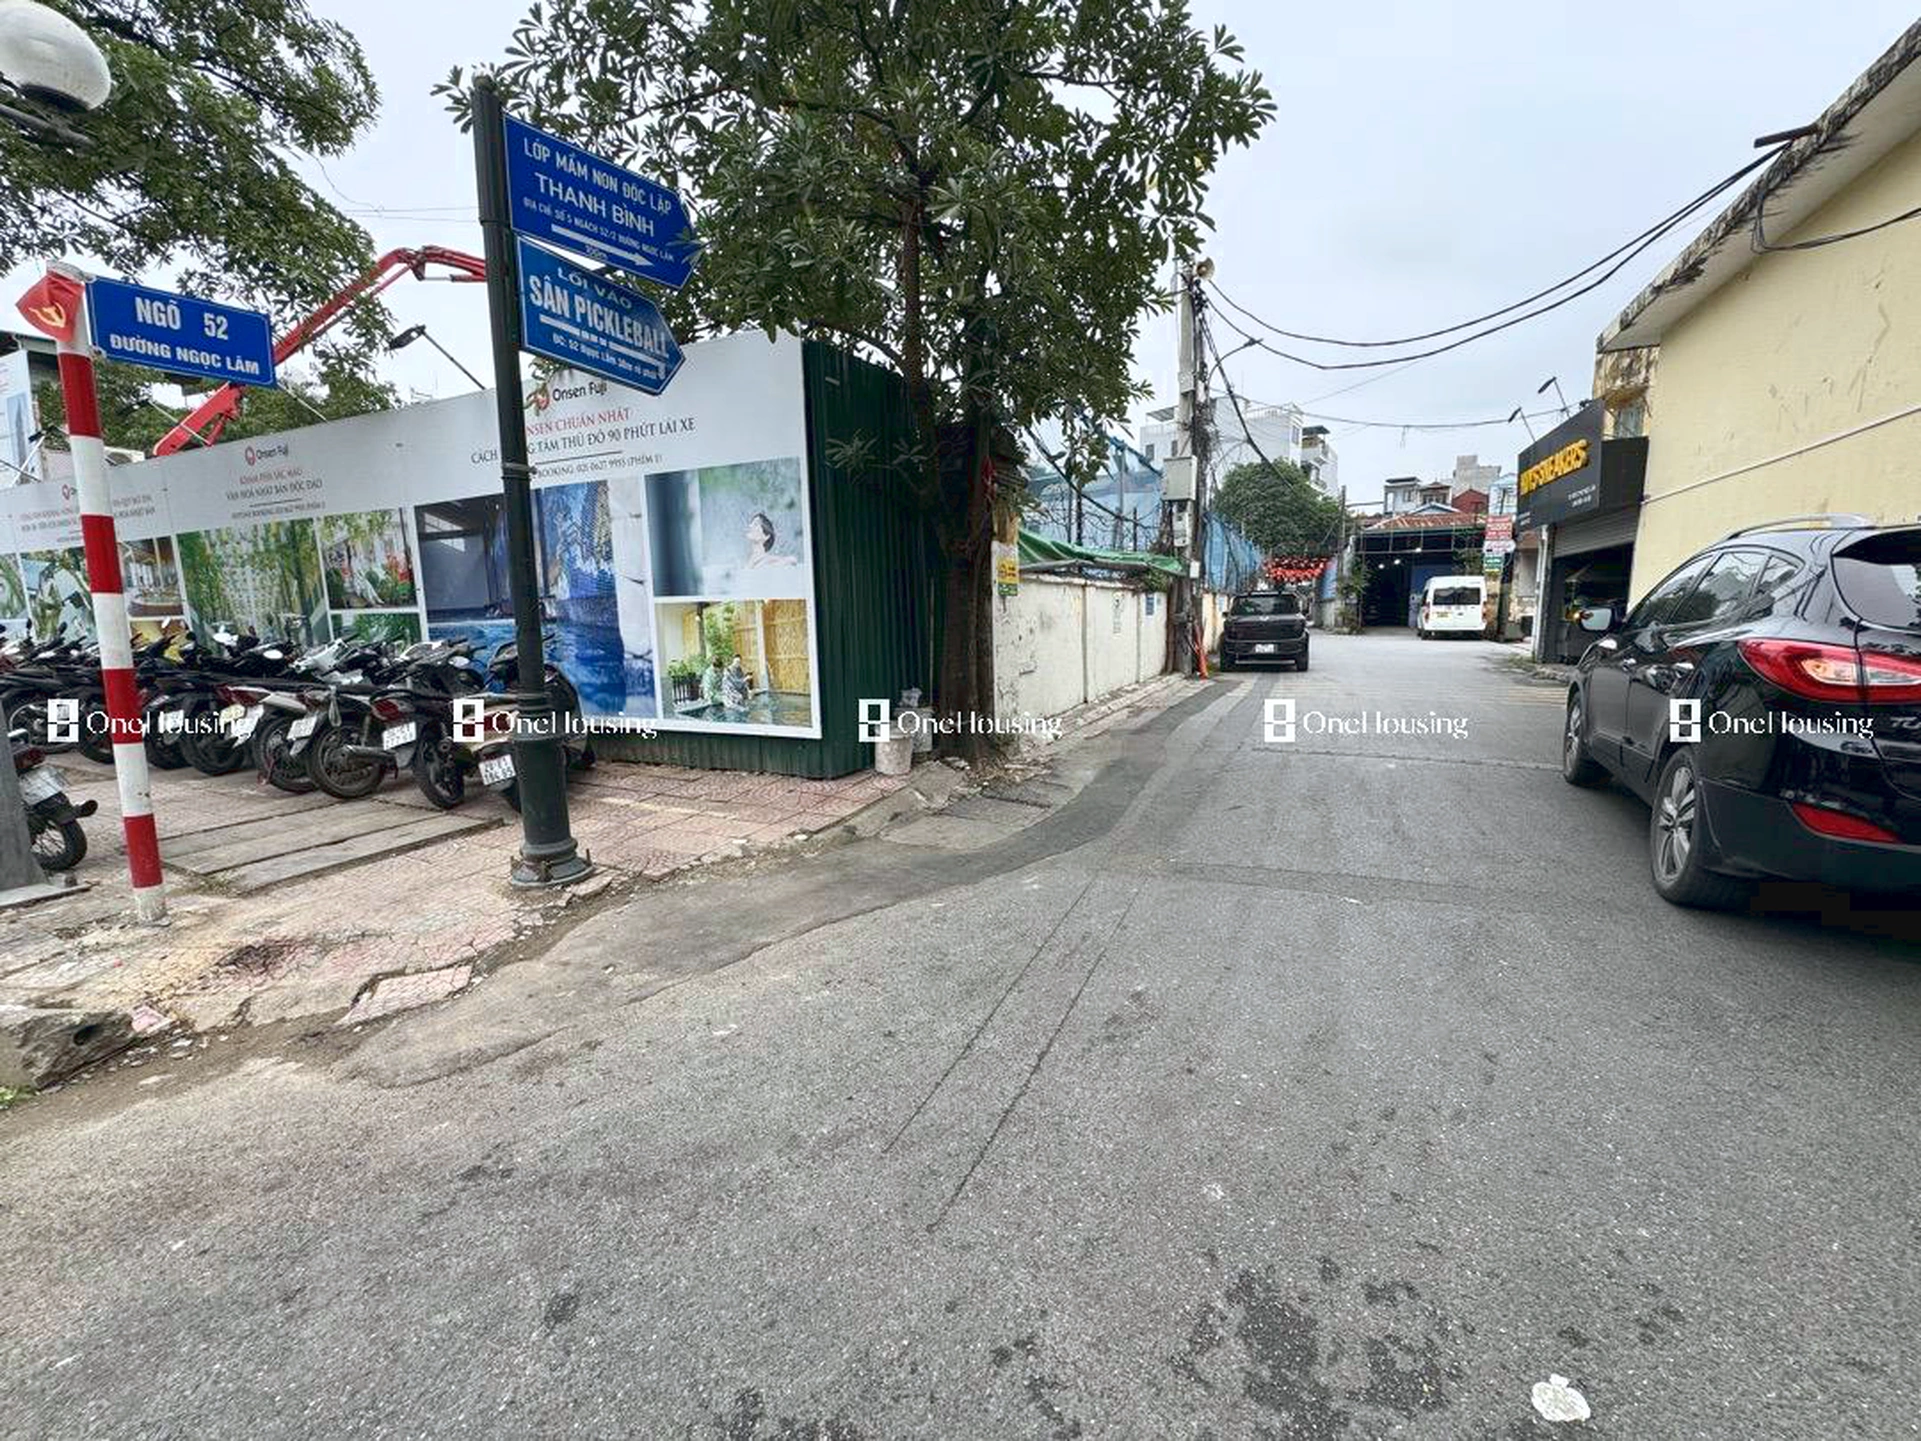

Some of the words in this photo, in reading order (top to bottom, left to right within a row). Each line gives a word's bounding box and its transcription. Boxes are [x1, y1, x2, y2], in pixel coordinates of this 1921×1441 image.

[524, 137, 551, 163] LỚP
[555, 152, 588, 181] MẦM
[592, 168, 618, 194] NON
[622, 182, 646, 207] ĐỘC
[650, 194, 672, 217] LẬP
[534, 172, 606, 218] THANH
[612, 203, 655, 237] BÌNH
[135, 296, 182, 331] NGÕ
[203, 312, 229, 341] 52
[529, 274, 570, 318] SÂN
[575, 294, 670, 358] PICKLEBALL
[110, 334, 171, 358] ĐƯỜNG
[176, 349, 221, 369] NGỌC
[225, 356, 260, 375] LÂM
[553, 386, 586, 401] Onsen
[526, 421, 553, 436] NSEN
[624, 422, 656, 440] PHÚT
[680, 417, 696, 431] XE
